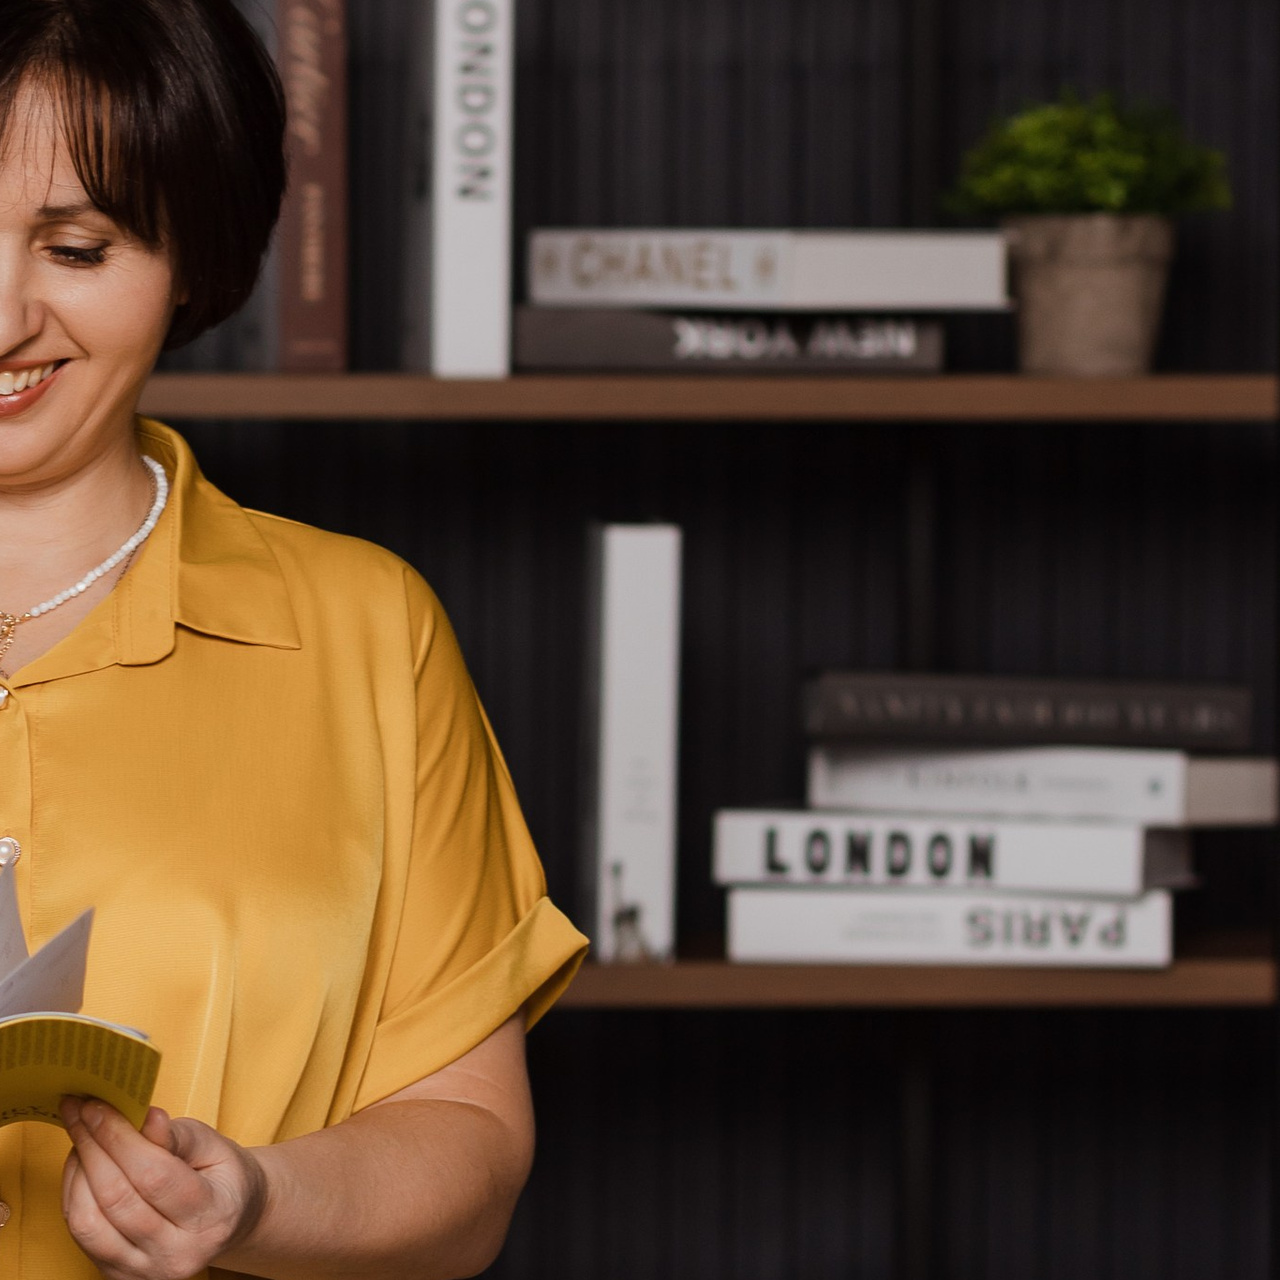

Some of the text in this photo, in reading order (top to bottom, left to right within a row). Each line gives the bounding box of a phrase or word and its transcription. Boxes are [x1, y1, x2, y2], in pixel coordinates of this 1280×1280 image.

[568, 234, 739, 292] CHANEL
[673, 318, 800, 359] YORK
[763, 826, 997, 881] LONDON
[966, 905, 1127, 949] PARIS
